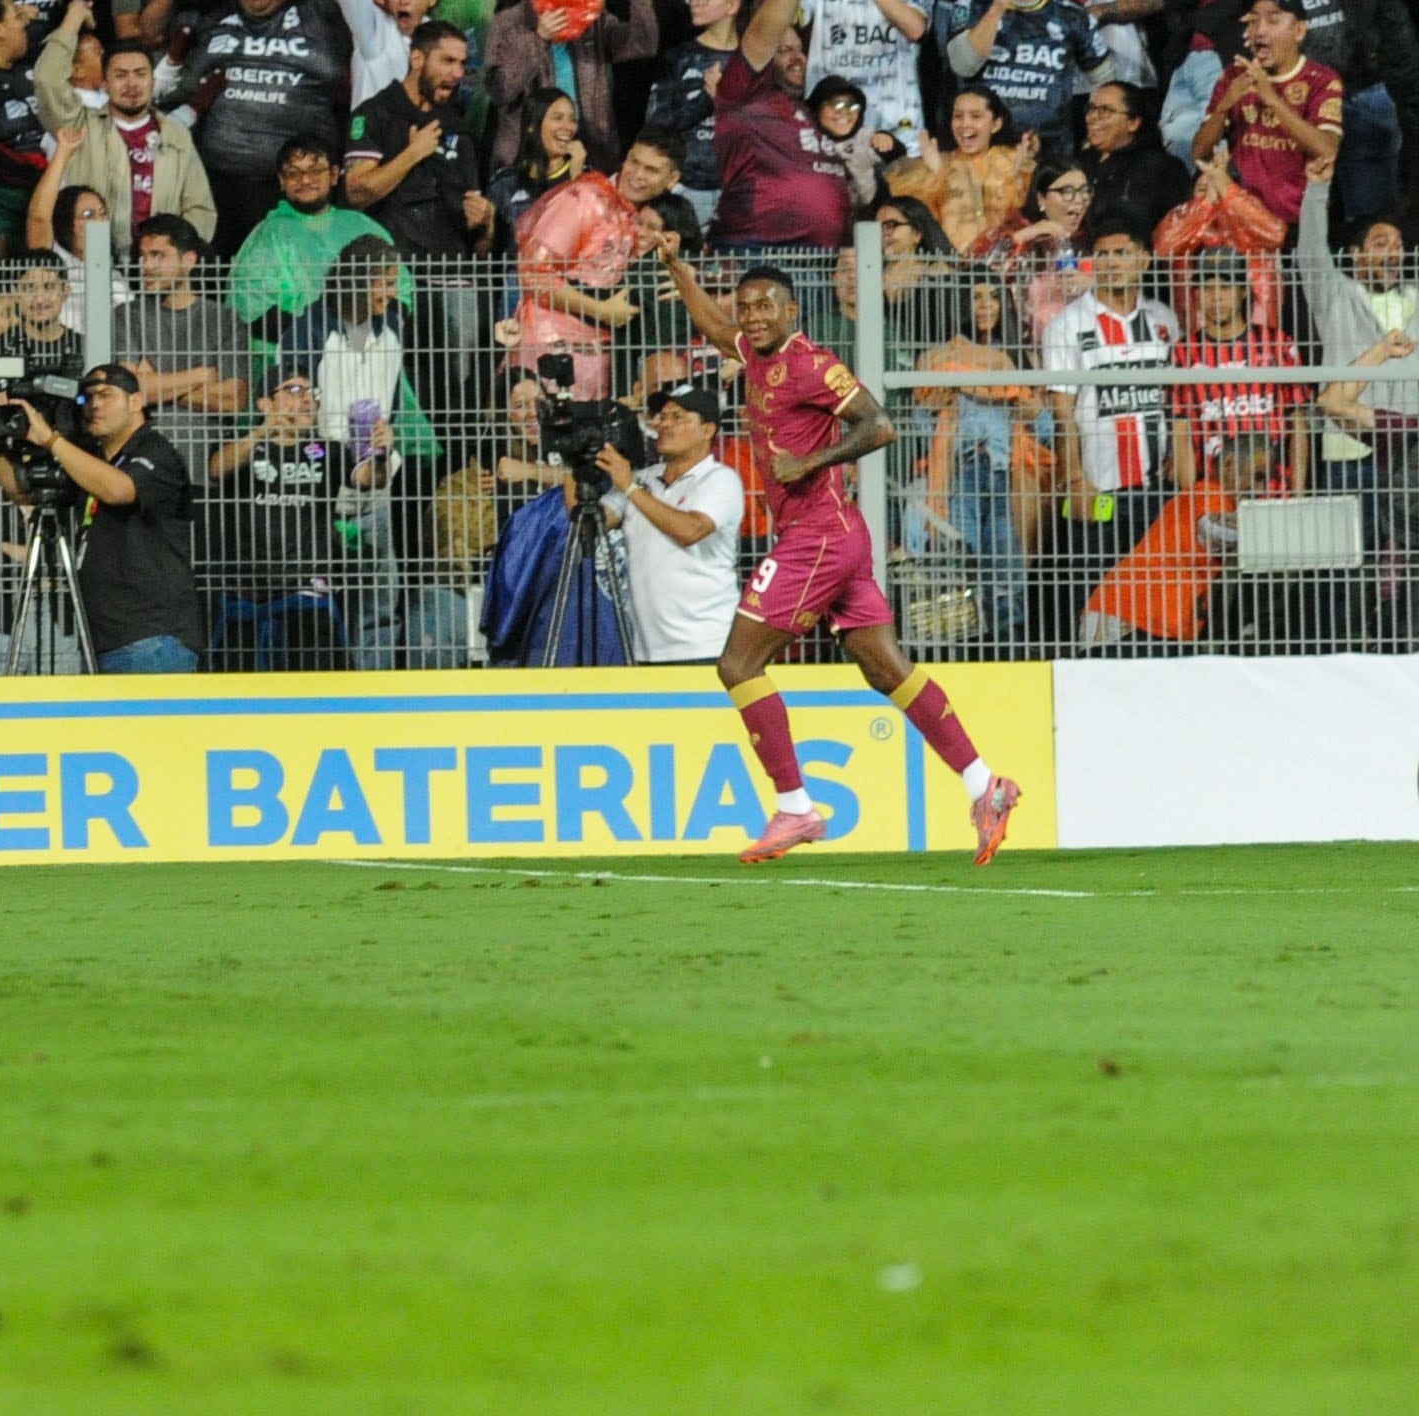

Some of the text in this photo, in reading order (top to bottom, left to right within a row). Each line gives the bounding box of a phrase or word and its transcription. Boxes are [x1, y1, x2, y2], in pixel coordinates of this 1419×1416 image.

[853, 25, 897, 45] BAC
[242, 35, 309, 58] BAC
[1014, 44, 1064, 70] BAC
[830, 54, 894, 68] LIBERTY
[223, 88, 287, 105] OMNILIFE
[281, 461, 323, 480] BAC
[751, 557, 778, 594] 9
[205, 738, 861, 848] BATERIAS
